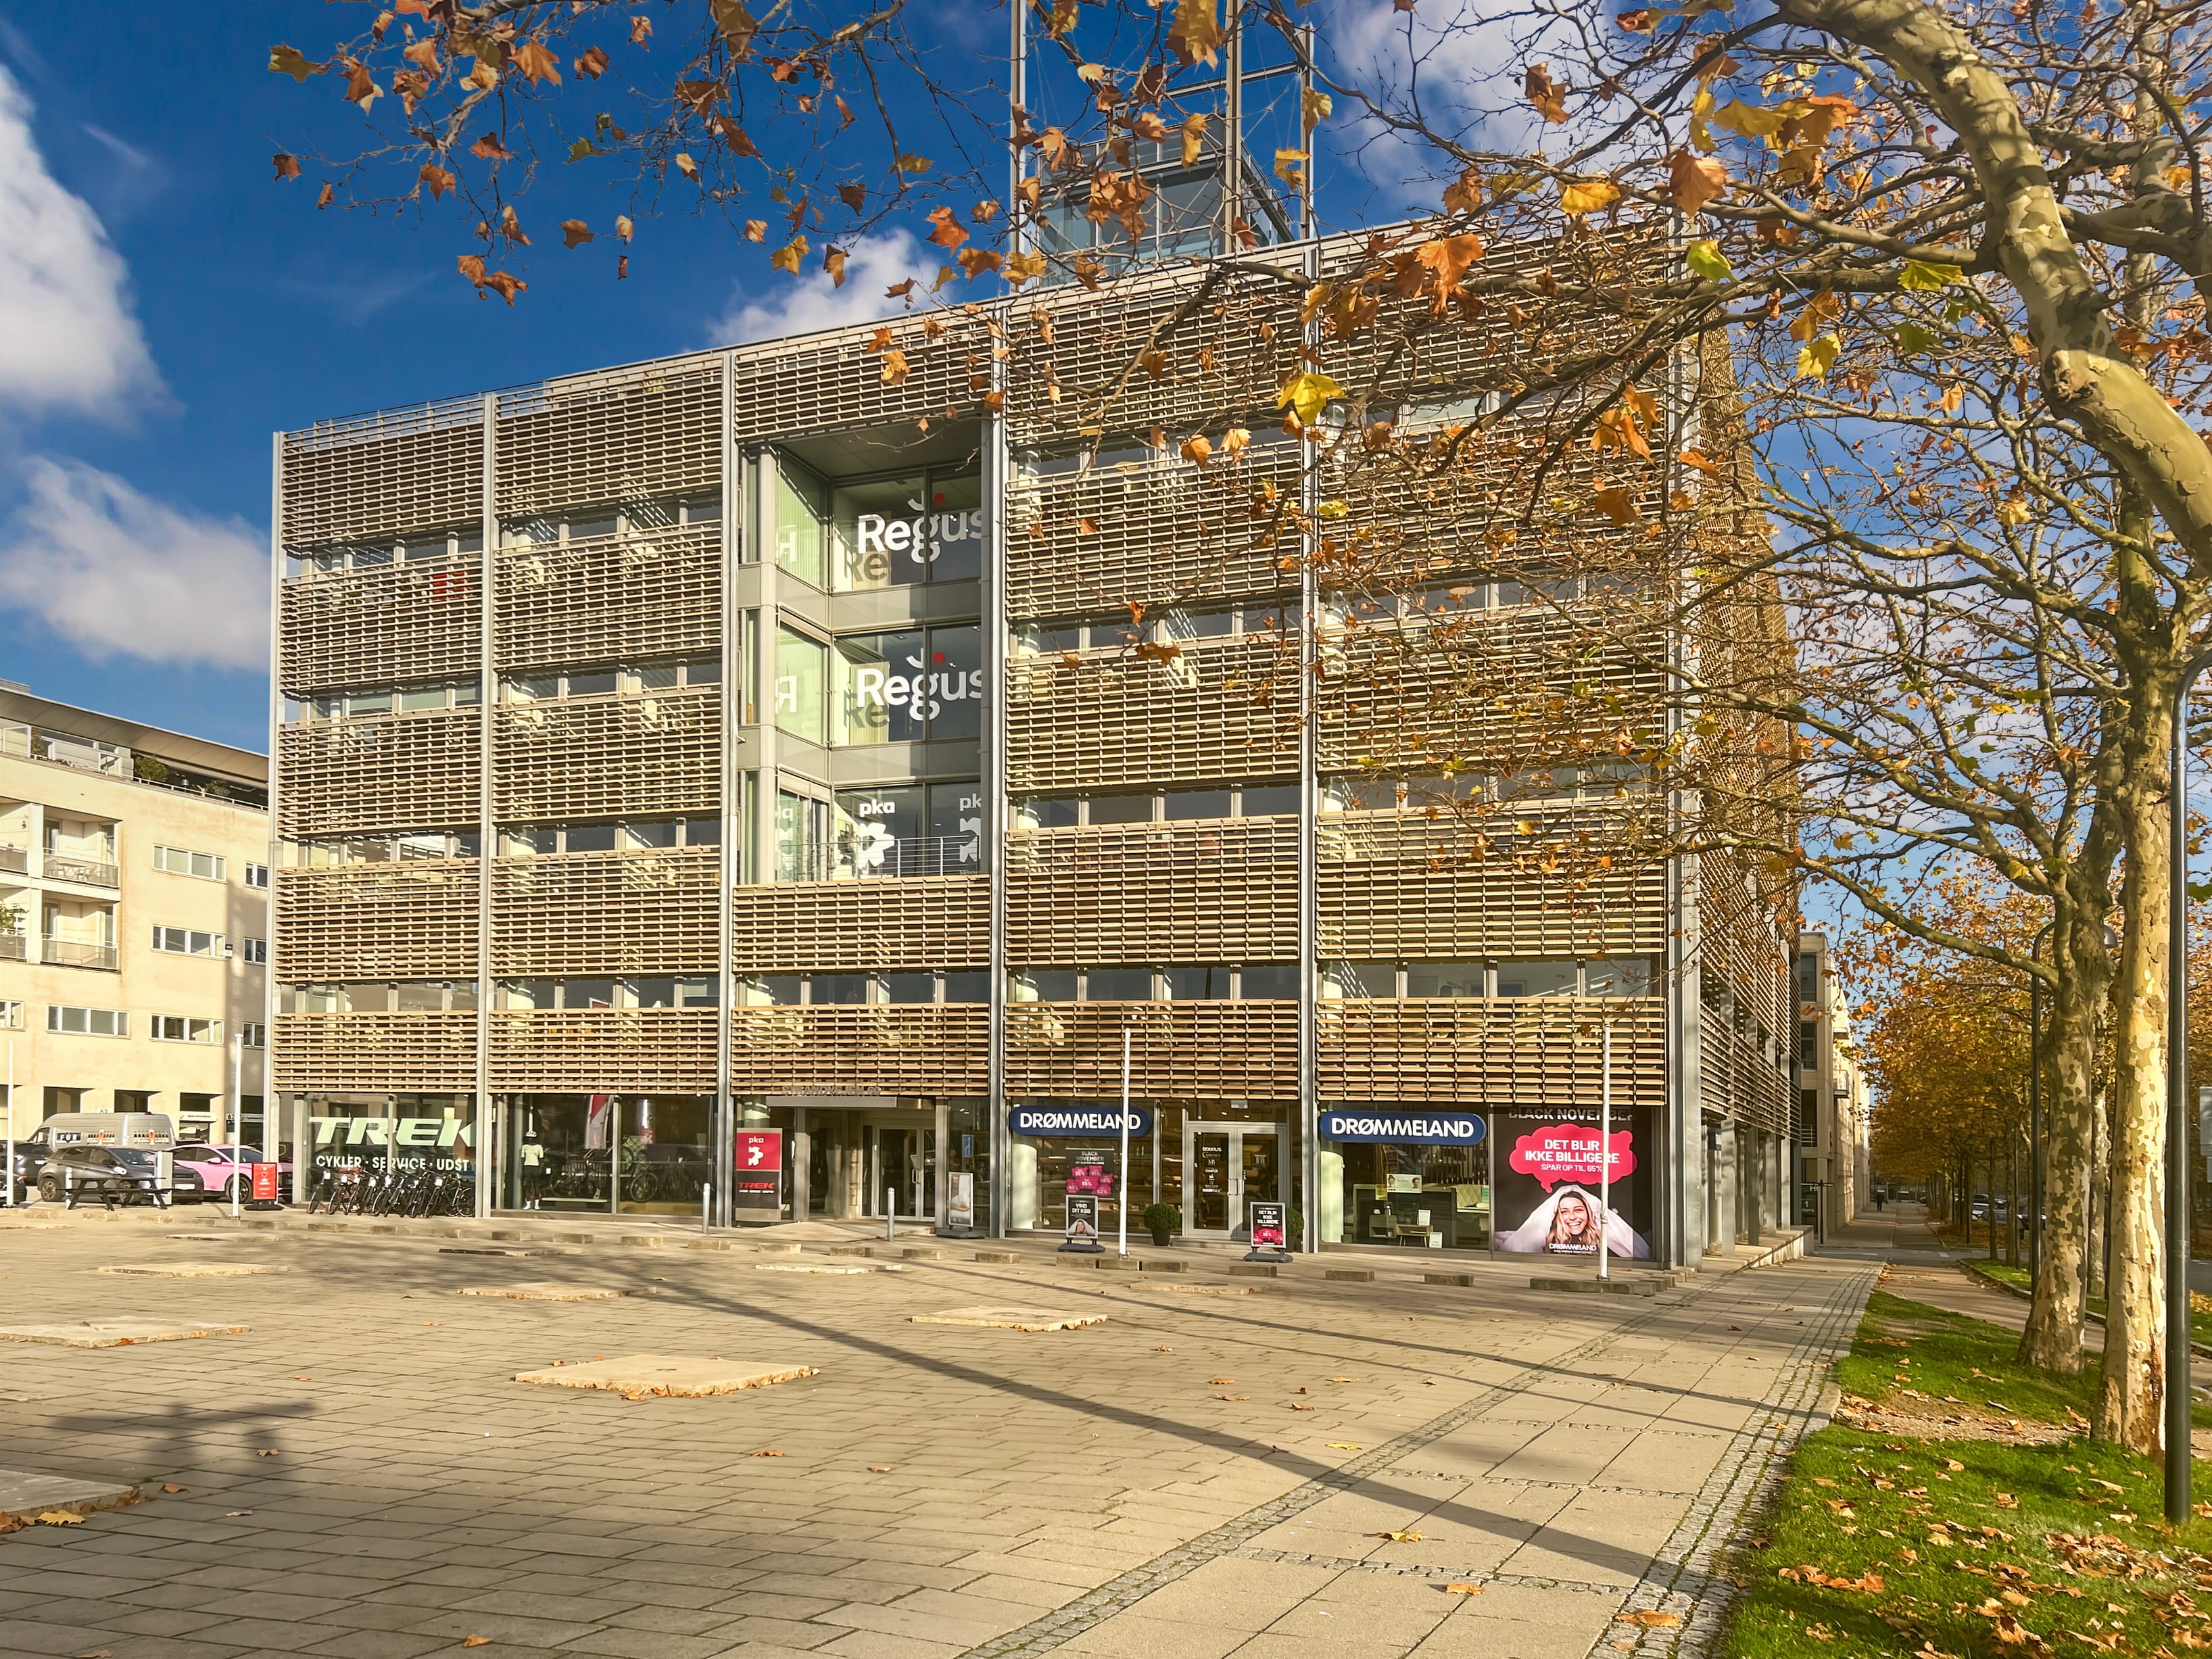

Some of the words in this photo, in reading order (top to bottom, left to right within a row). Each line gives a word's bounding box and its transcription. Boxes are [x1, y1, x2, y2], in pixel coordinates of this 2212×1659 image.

[859, 799, 896, 817] pka
[1508, 1107, 1554, 1120] BLACK
[1019, 1112, 1141, 1130] DRØMMELAND
[1331, 1117, 1474, 1138] DRØMMELAND
[308, 1117, 477, 1147] TREK
[1544, 1139, 1569, 1150] DET
[1571, 1140, 1600, 1151] BLIR
[316, 1155, 362, 1168] CYKLER
[1525, 1151, 1554, 1161] IKKE
[1549, 1243, 1597, 1251] DRØMMELAND
